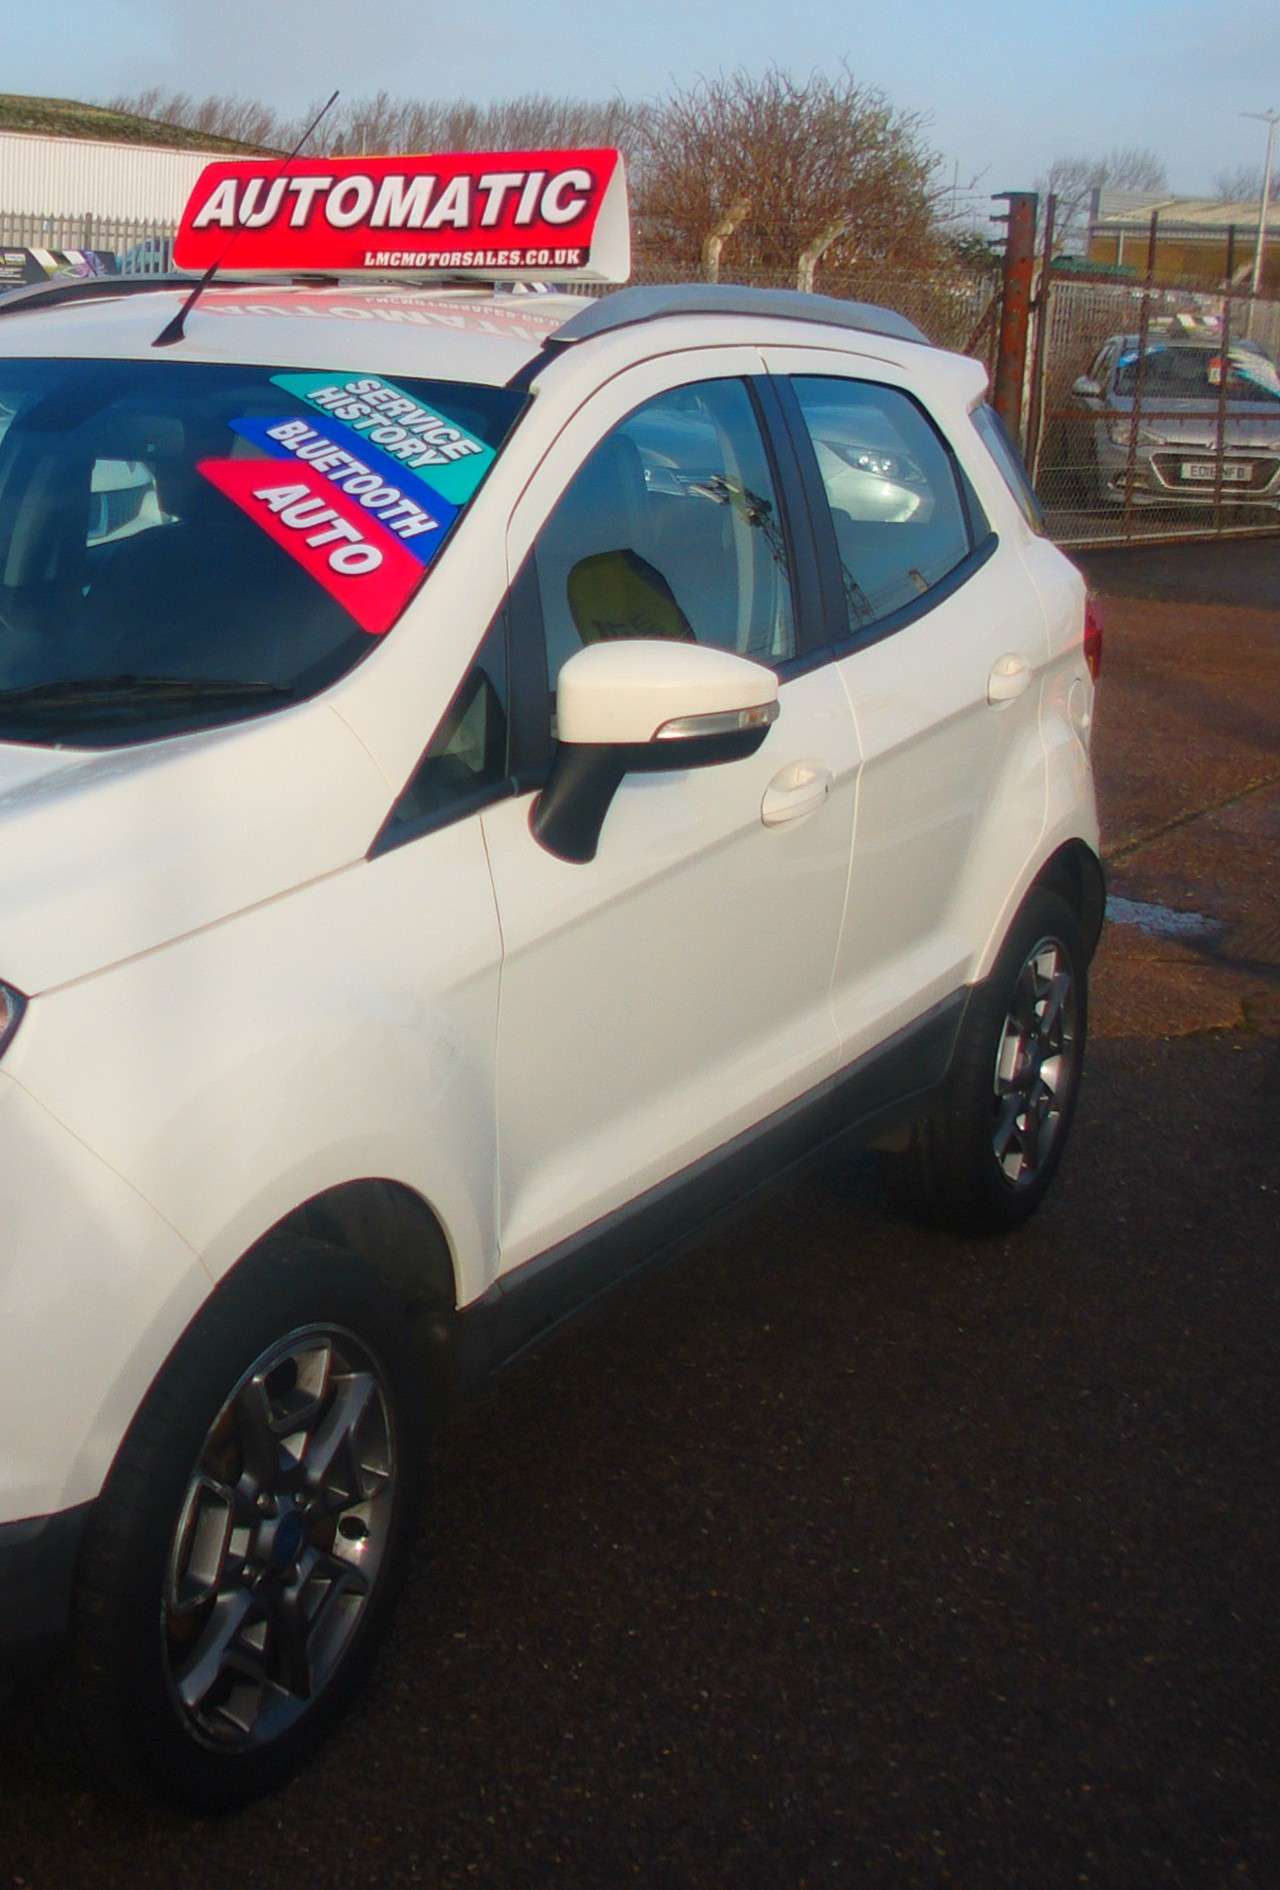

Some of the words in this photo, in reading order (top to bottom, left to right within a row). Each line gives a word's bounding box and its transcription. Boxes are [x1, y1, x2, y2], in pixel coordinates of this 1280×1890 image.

[191, 167, 592, 229] AUTOMATIC
[363, 248, 581, 267] LMCMOTORSALES.CO.UK
[307, 386, 453, 469] HISTORY
[344, 378, 483, 460] SERVICE
[265, 420, 439, 539] BLUETOOTH
[252, 484, 384, 576] AUTO
